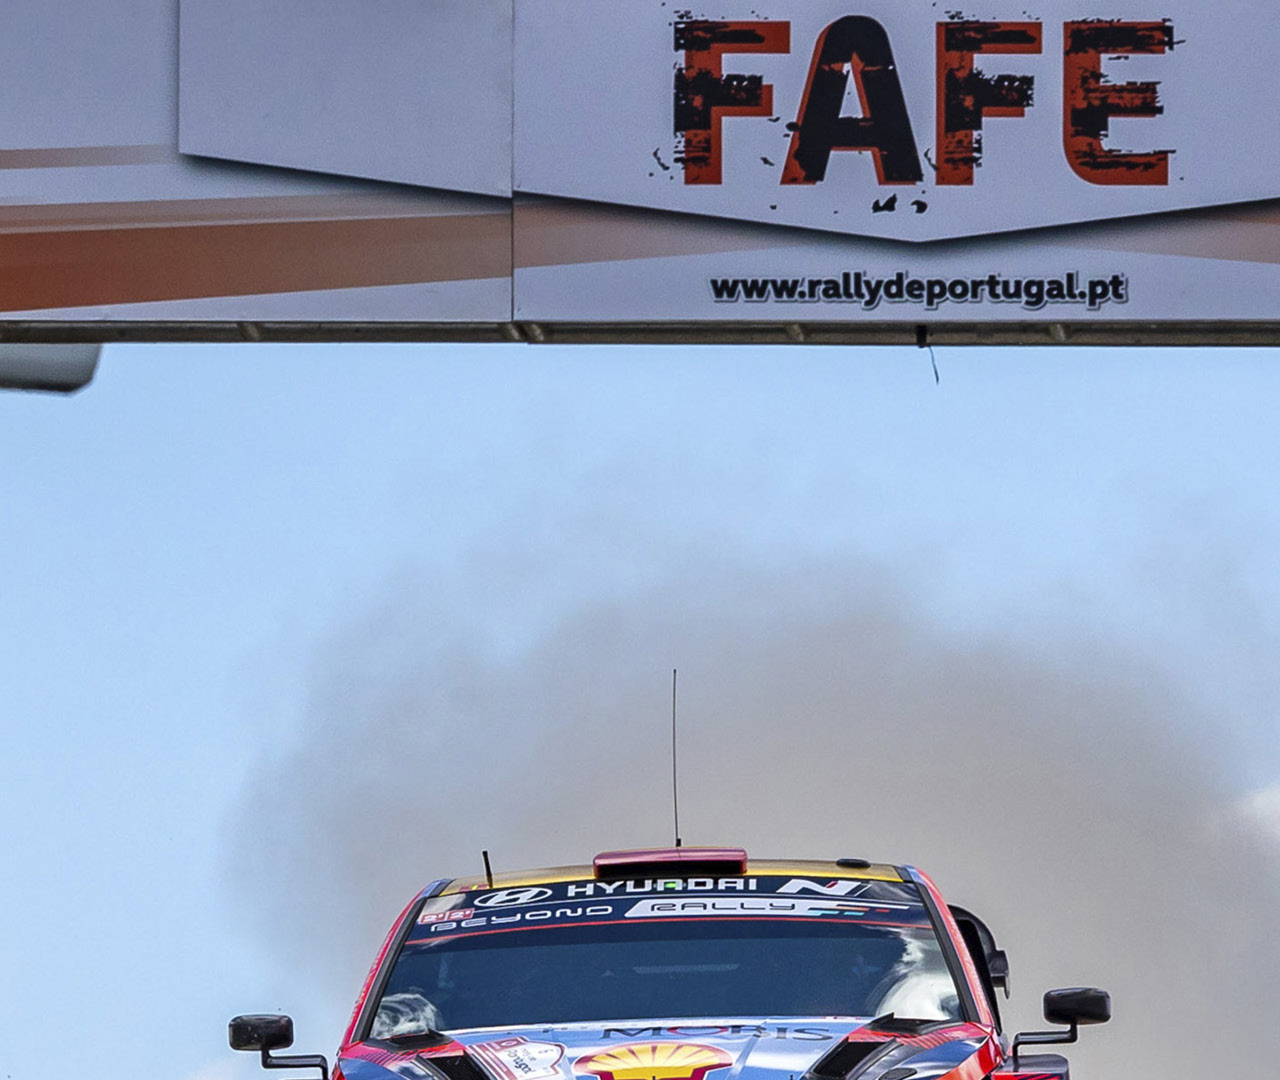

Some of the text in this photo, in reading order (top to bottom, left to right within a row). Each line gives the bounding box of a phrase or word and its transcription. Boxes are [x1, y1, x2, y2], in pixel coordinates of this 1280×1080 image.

[673, 15, 1176, 186] FAFE
[710, 272, 1127, 307] www.rallydeportugal.pt
[567, 879, 758, 898] HYUNDAI
[430, 905, 614, 932] BEYOND
[650, 902, 796, 912] RALLY
[601, 1025, 834, 1041] MOBIS
